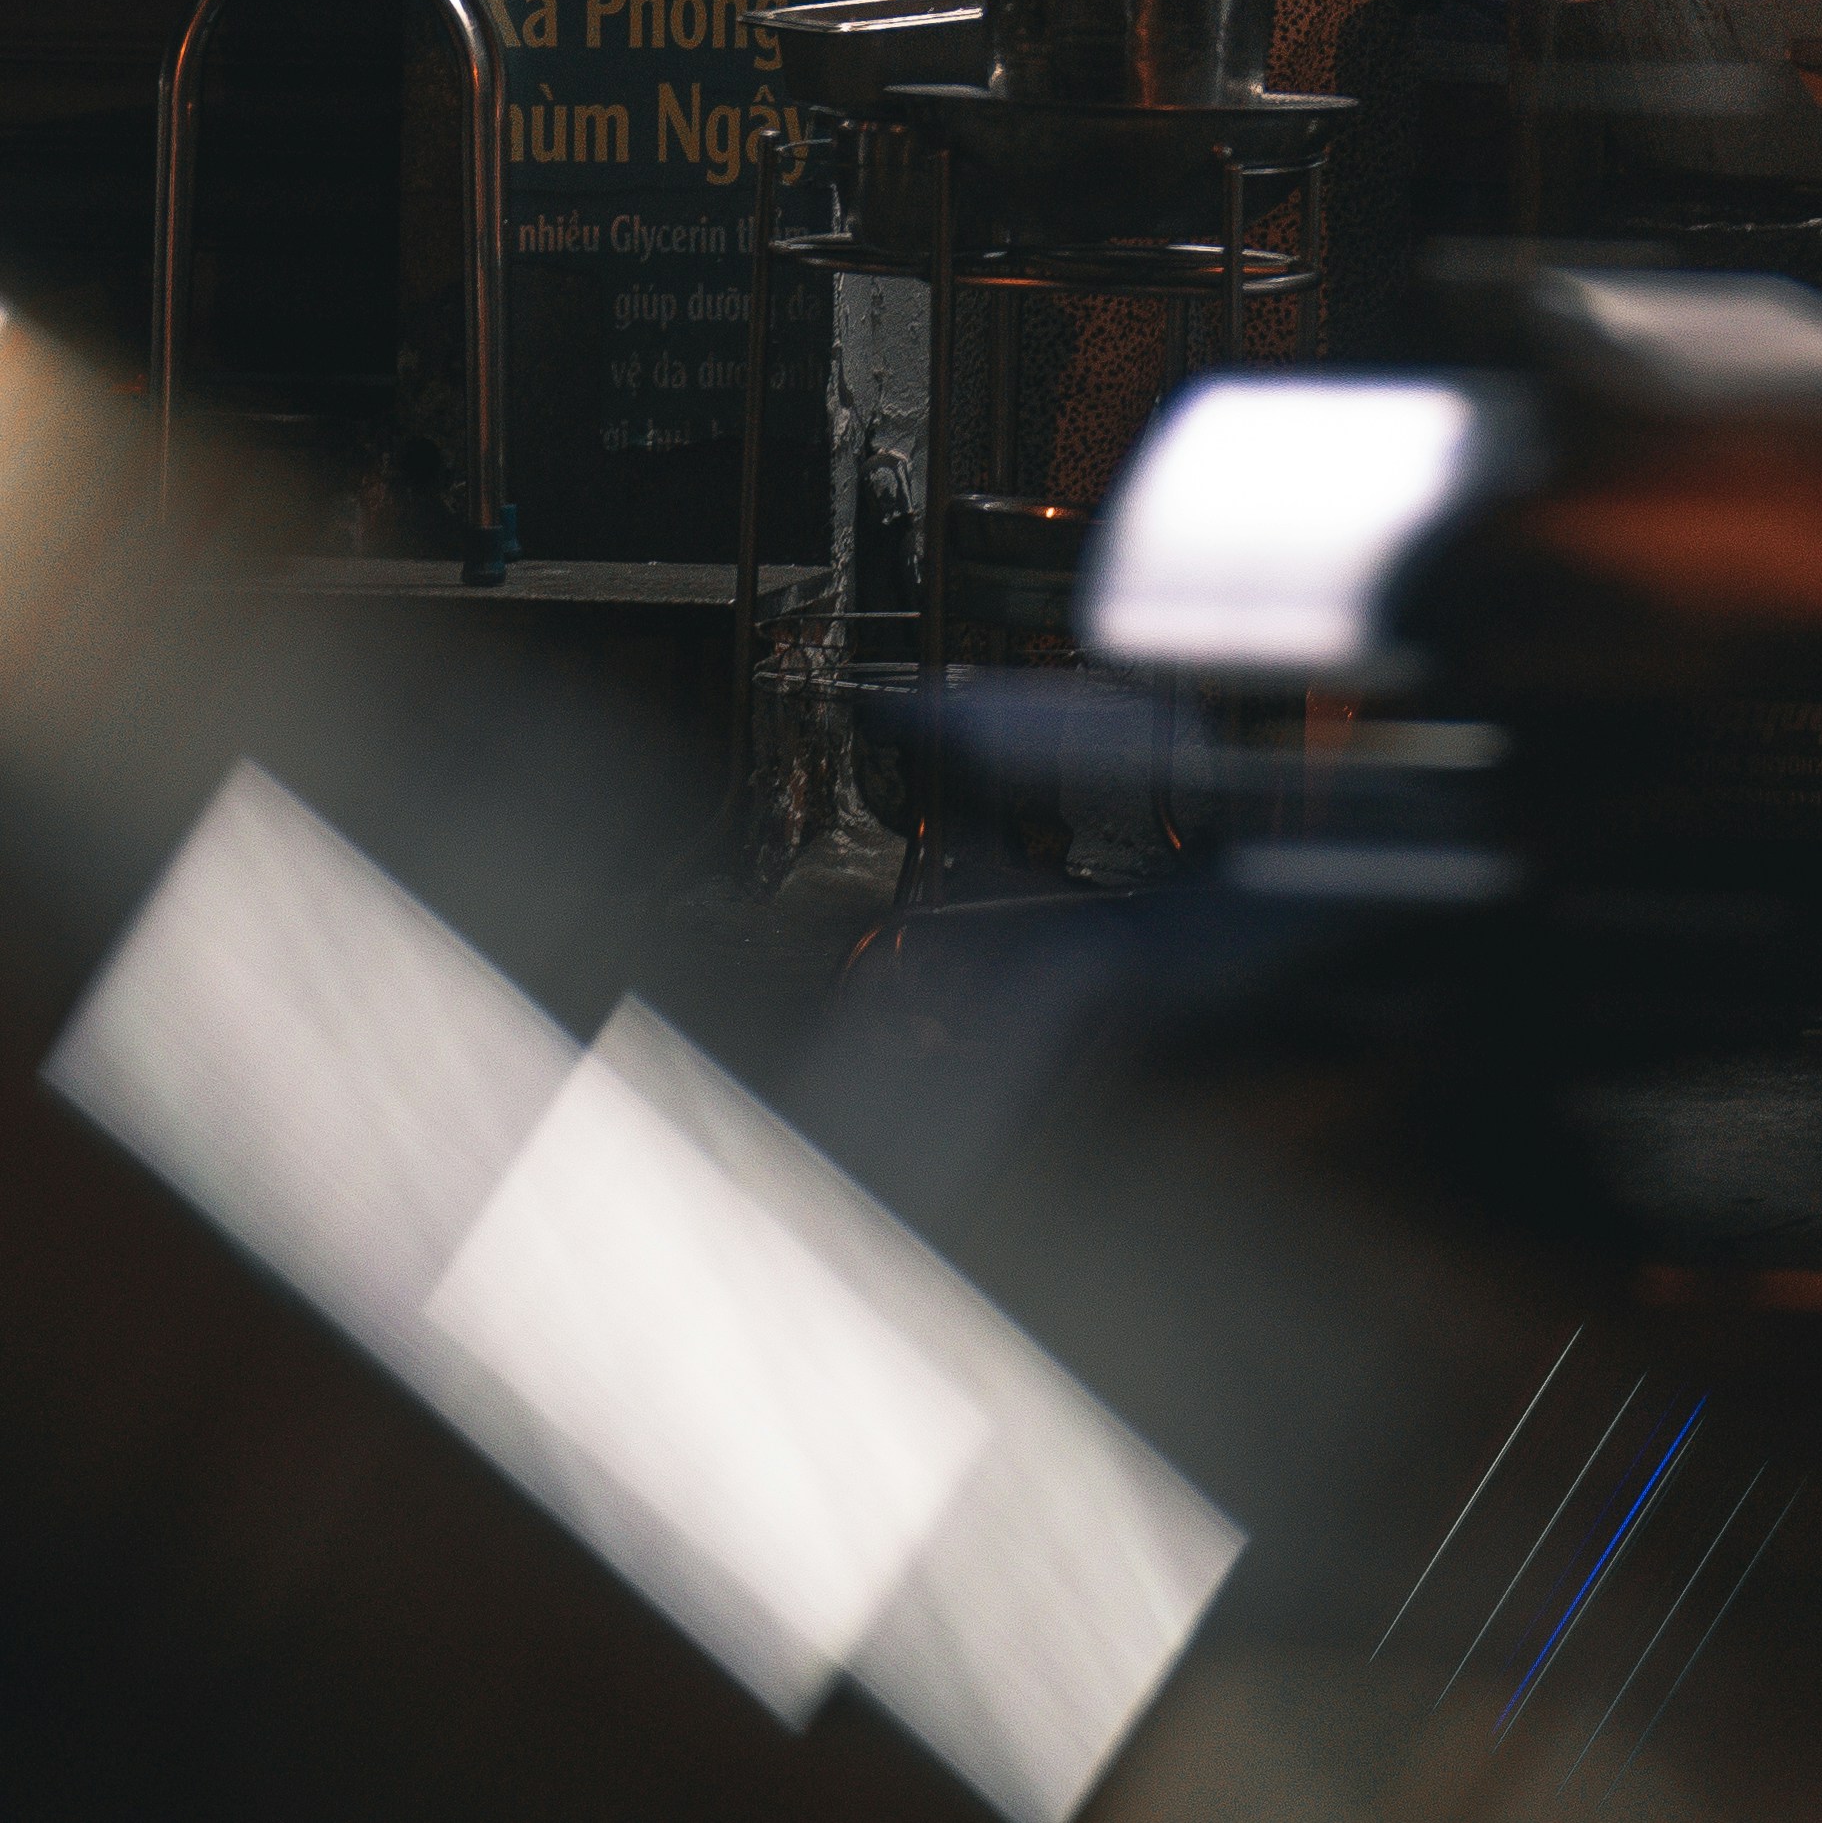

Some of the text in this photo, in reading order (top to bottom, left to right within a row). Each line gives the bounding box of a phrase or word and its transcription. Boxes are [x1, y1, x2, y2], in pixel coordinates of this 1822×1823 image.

[508, 82, 809, 186] hùm Ngây
[610, 213, 727, 264] Glycerin
[613, 283, 677, 330] giúp
[687, 283, 778, 330] dưỡ
